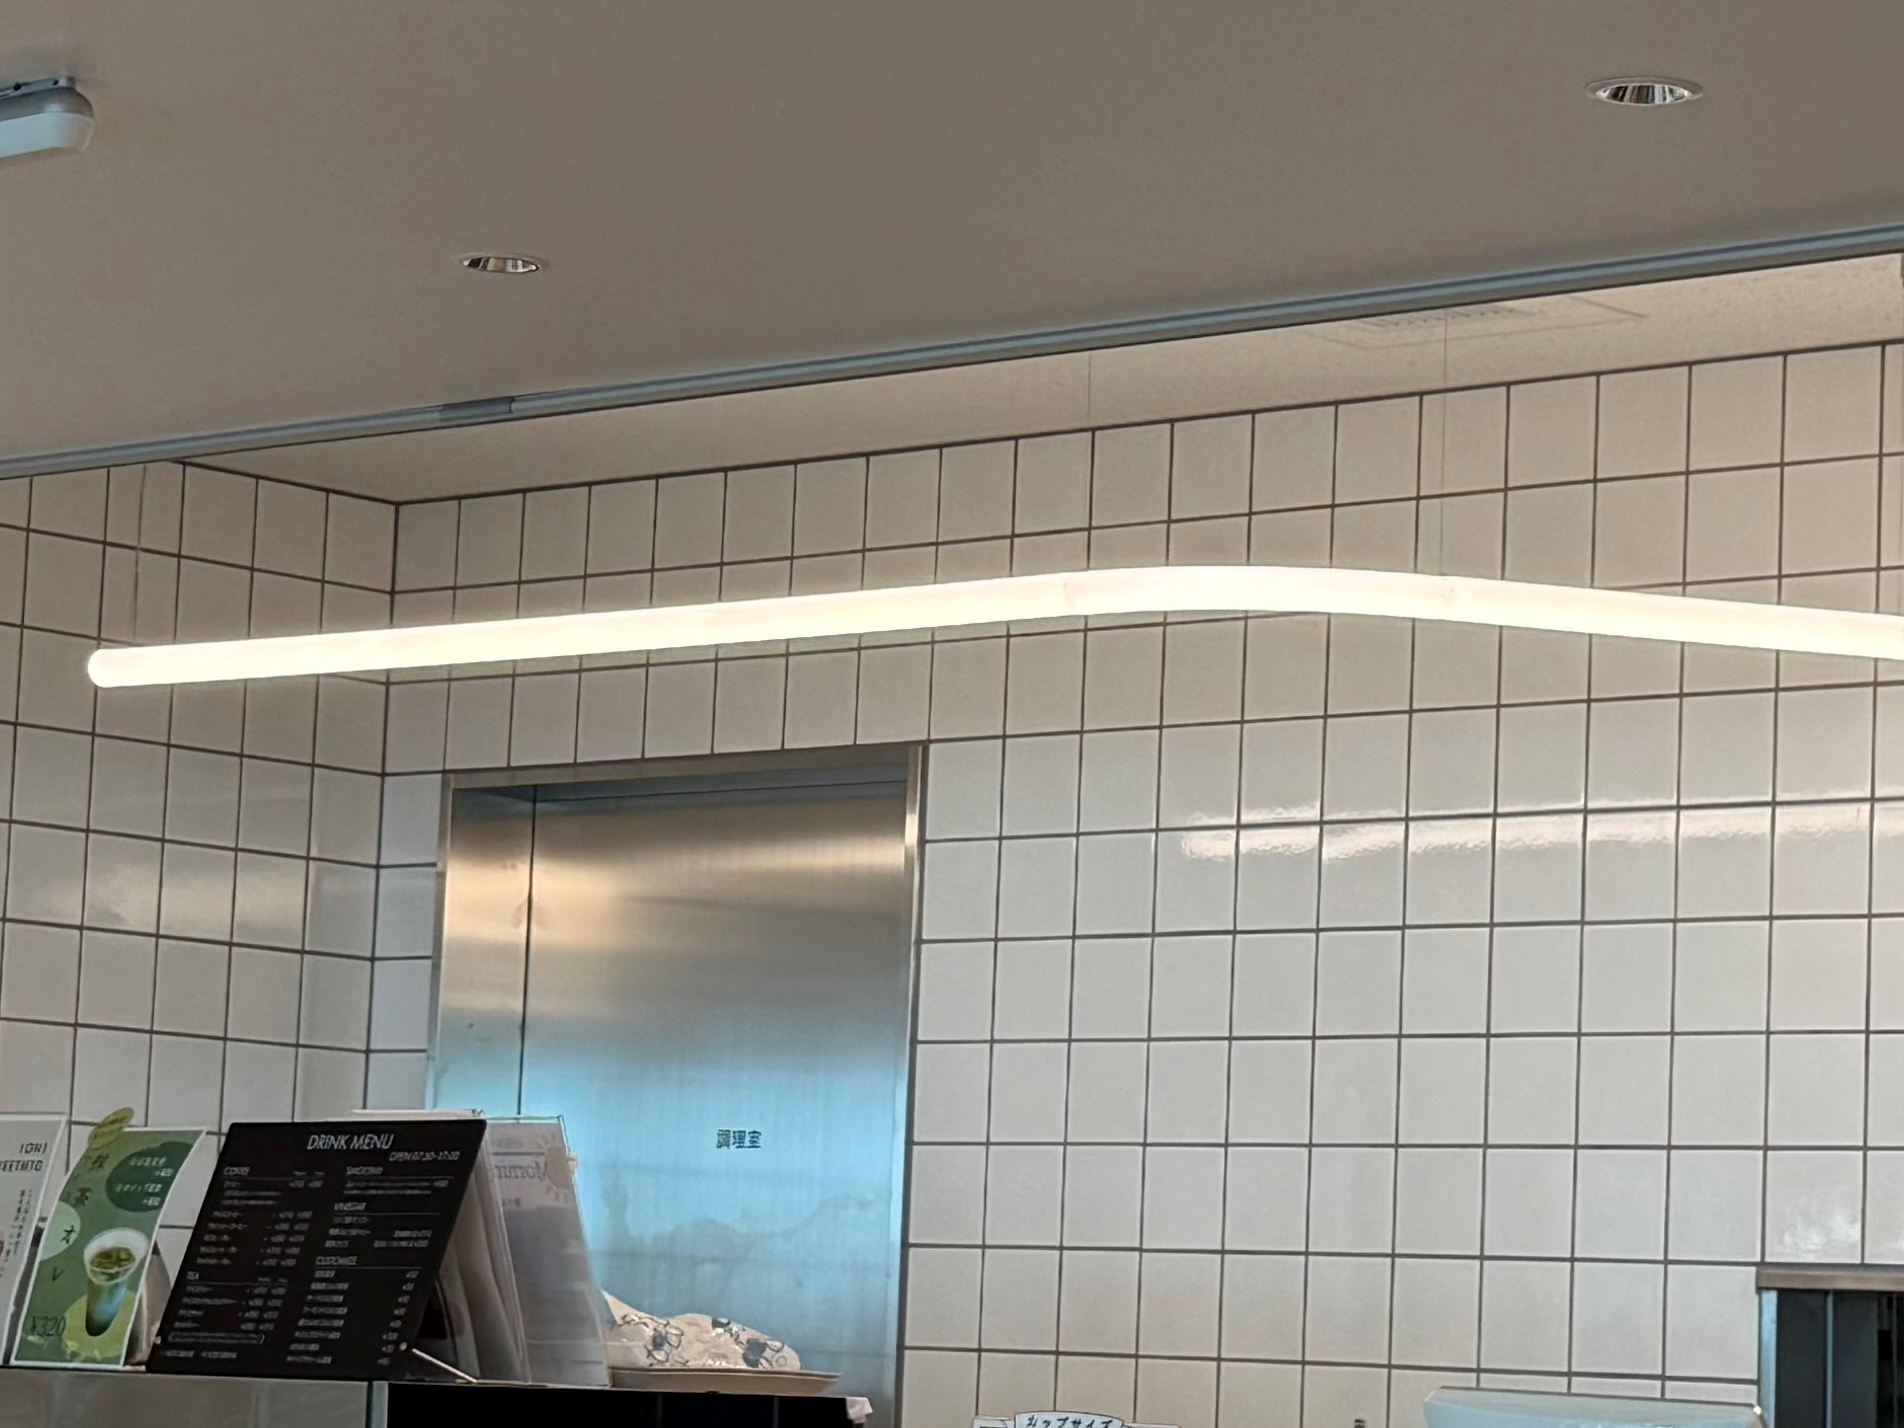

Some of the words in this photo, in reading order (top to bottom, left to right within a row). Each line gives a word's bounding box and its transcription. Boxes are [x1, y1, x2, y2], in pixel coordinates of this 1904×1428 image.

[306, 1134, 349, 1150] DRINK
[350, 1133, 395, 1150] MENU
[716, 1129, 762, 1149] 調理室
